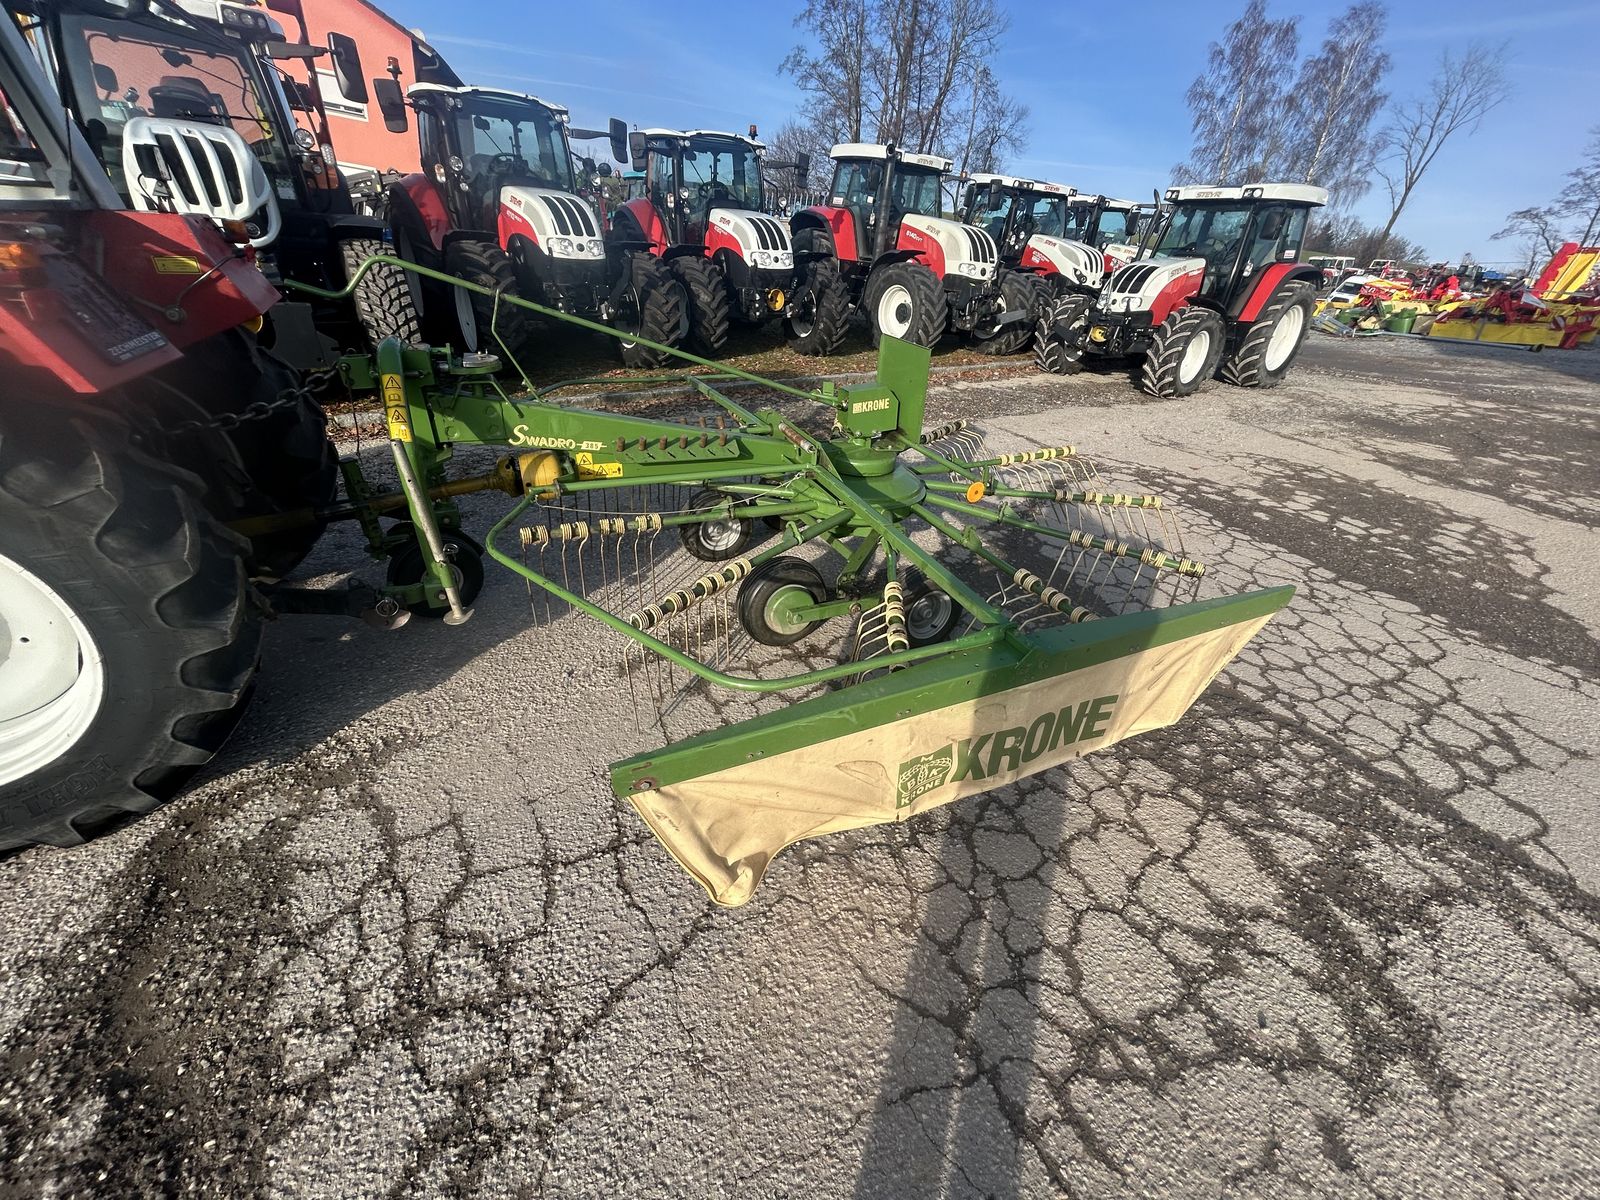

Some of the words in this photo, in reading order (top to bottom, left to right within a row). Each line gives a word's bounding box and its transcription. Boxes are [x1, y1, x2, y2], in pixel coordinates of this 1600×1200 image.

[925, 224, 941, 237] STEYR
[107, 330, 162, 356] ZECHMEISTER
[862, 398, 890, 413] KRONE
[585, 442, 600, 450] 385
[949, 694, 1120, 784] KRONE
[920, 754, 935, 764] M
[928, 766, 943, 778] K
[900, 778, 943, 806] KRONE
